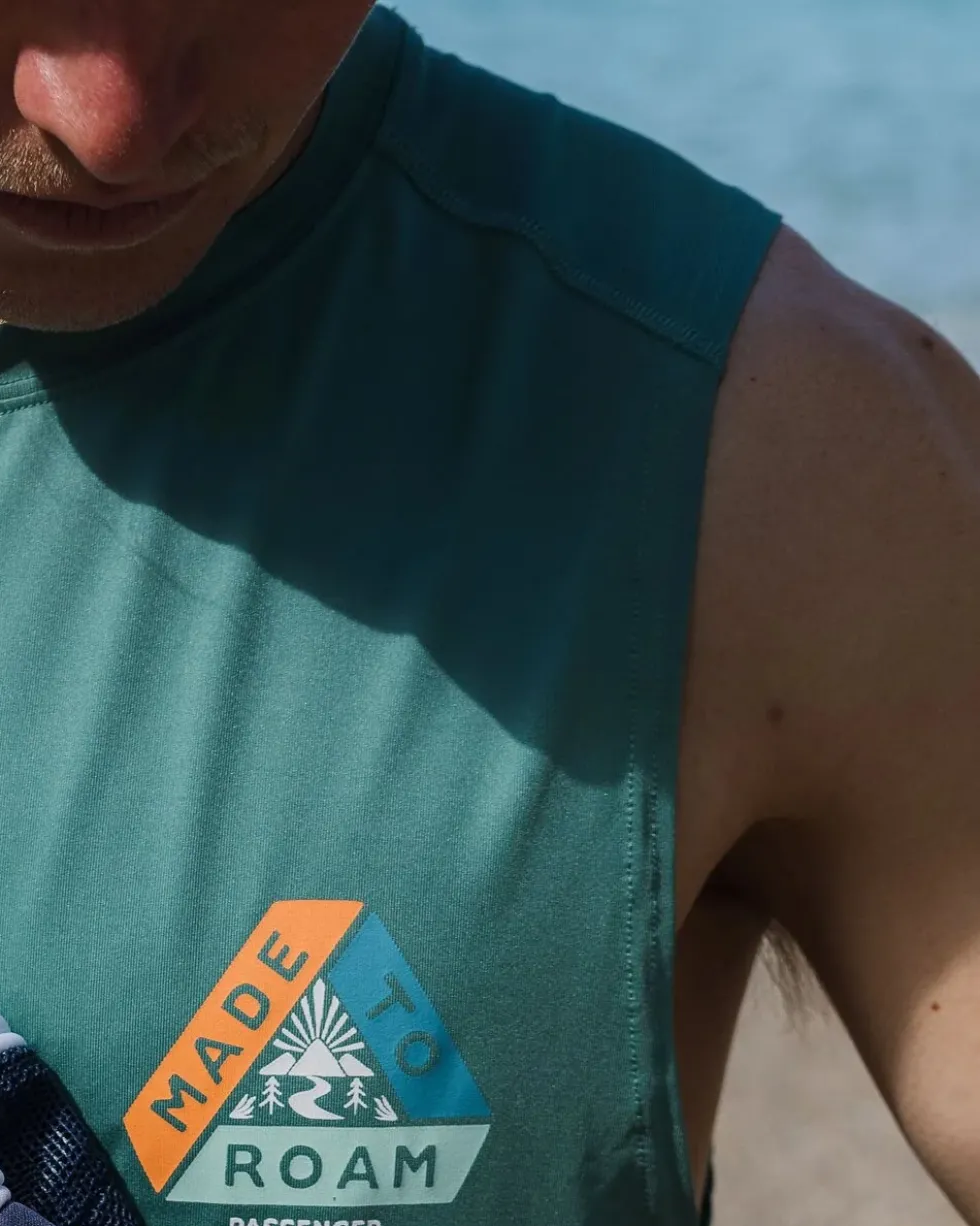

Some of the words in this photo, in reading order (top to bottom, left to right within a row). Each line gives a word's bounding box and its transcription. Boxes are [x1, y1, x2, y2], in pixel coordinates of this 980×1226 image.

[150, 930, 309, 1133] MADE
[365, 972, 439, 1077] TO
[224, 1143, 437, 1190] ROAM
